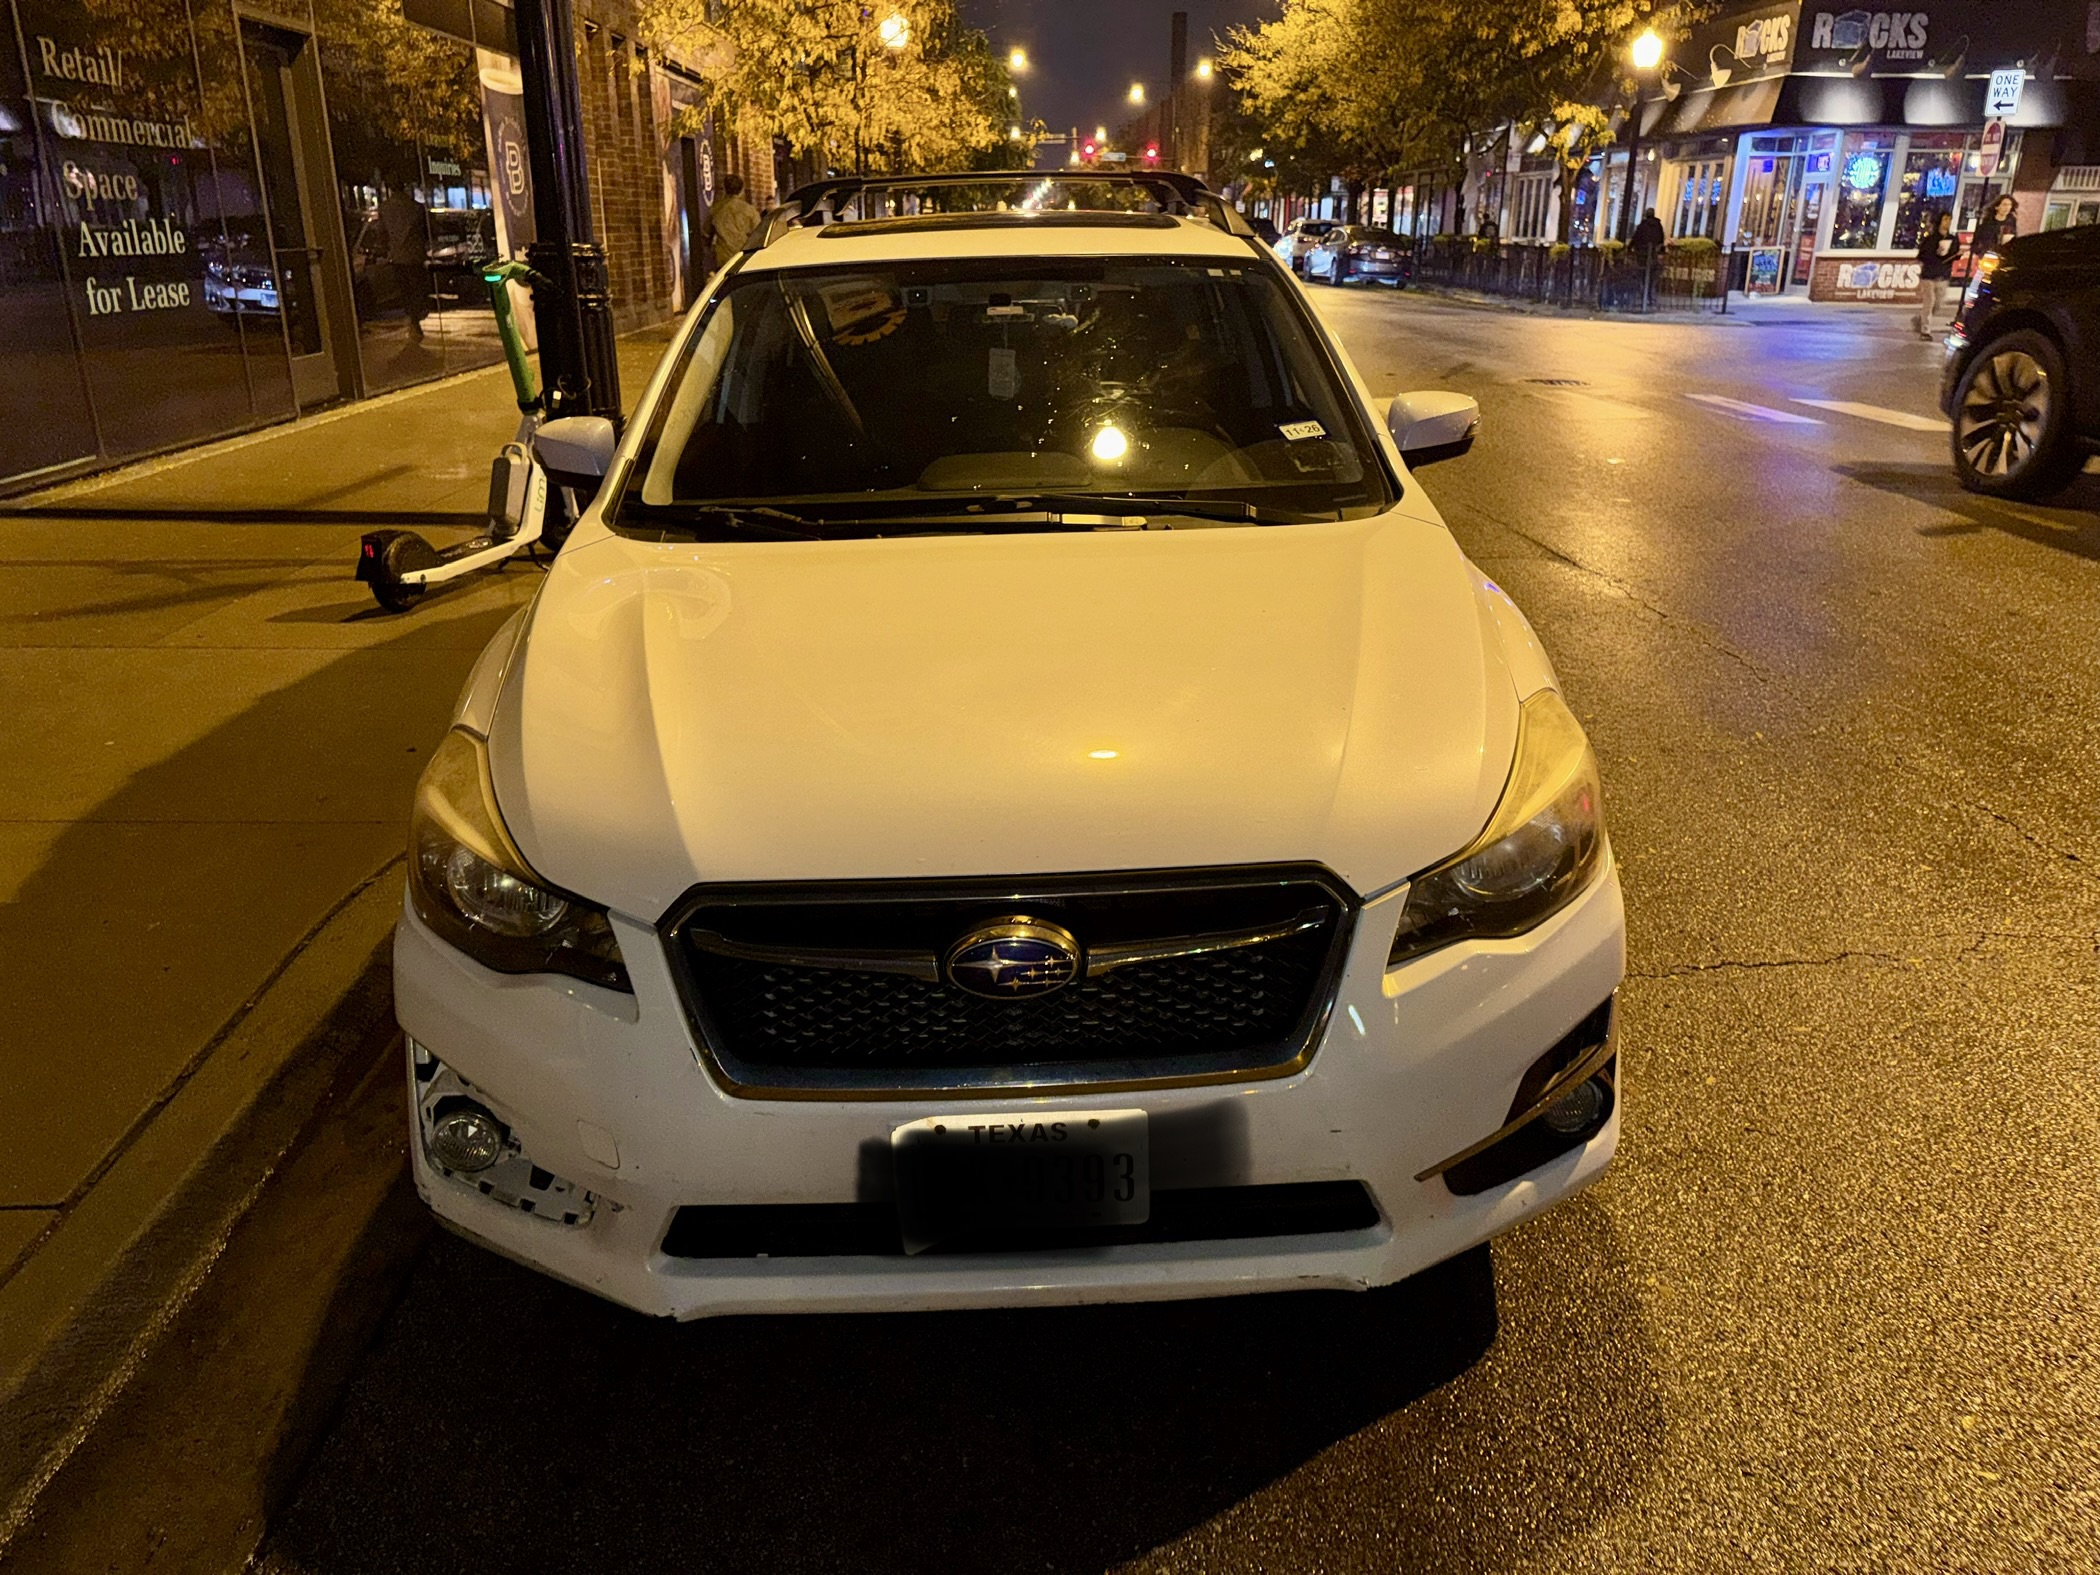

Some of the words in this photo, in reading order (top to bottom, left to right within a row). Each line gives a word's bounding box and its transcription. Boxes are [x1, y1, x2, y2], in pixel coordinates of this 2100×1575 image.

[37, 35, 122, 88] Retail/
[1995, 75, 2020, 85] ONE
[1993, 87, 2018, 98] WAY
[51, 100, 193, 149] Commercial
[63, 160, 139, 211] Space
[78, 217, 186, 258] Available
[86, 276, 122, 316] for
[126, 276, 190, 311] Lease
[967, 1122, 1068, 1144] TEXAS
